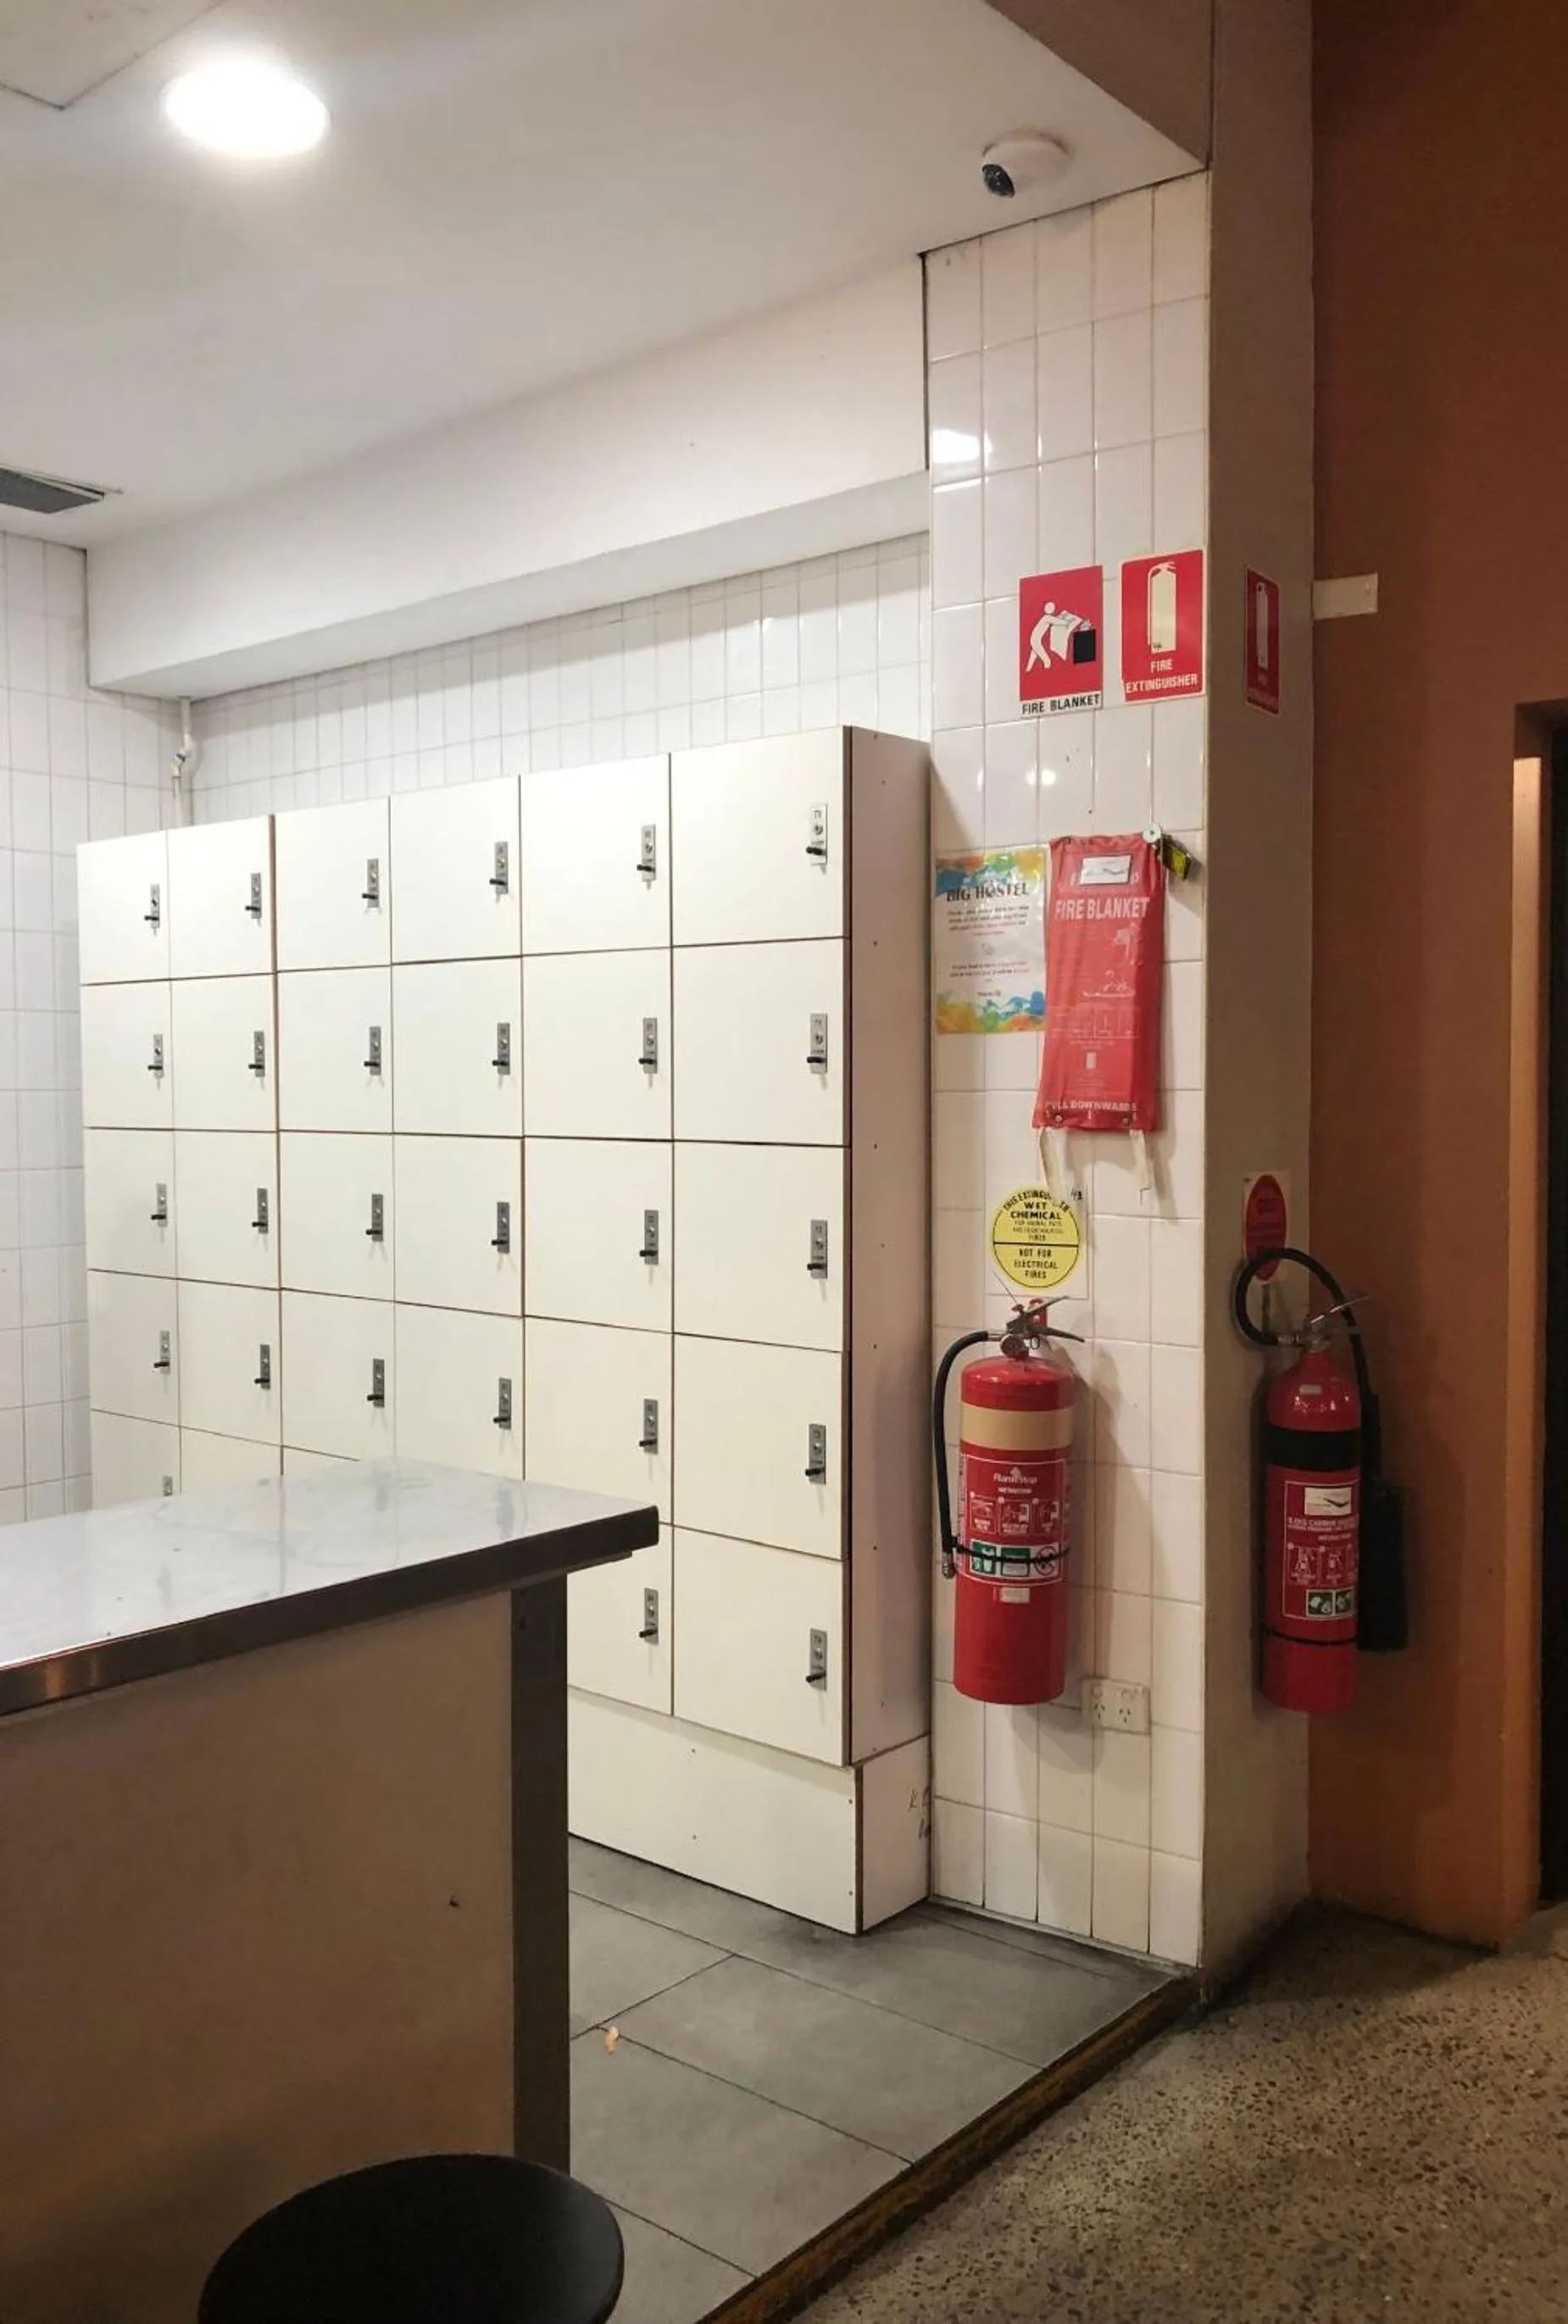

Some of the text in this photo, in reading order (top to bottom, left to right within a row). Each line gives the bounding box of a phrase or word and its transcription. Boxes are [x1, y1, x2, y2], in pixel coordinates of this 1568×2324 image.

[1150, 658, 1174, 675] FIRE
[1125, 673, 1198, 693] EXTINGUISHER
[1021, 694, 1100, 714] FIRE BLANKET
[1054, 898, 1085, 920] FIRE
[1086, 896, 1150, 920] BLANKET
[1024, 1202, 1048, 1210] WET
[1010, 1210, 1062, 1220] CHEMICAL
[1019, 1248, 1052, 1258] NOT FOR
[1014, 1260, 1059, 1270] ELECTRICAL
[1025, 1270, 1047, 1279] FIRES
